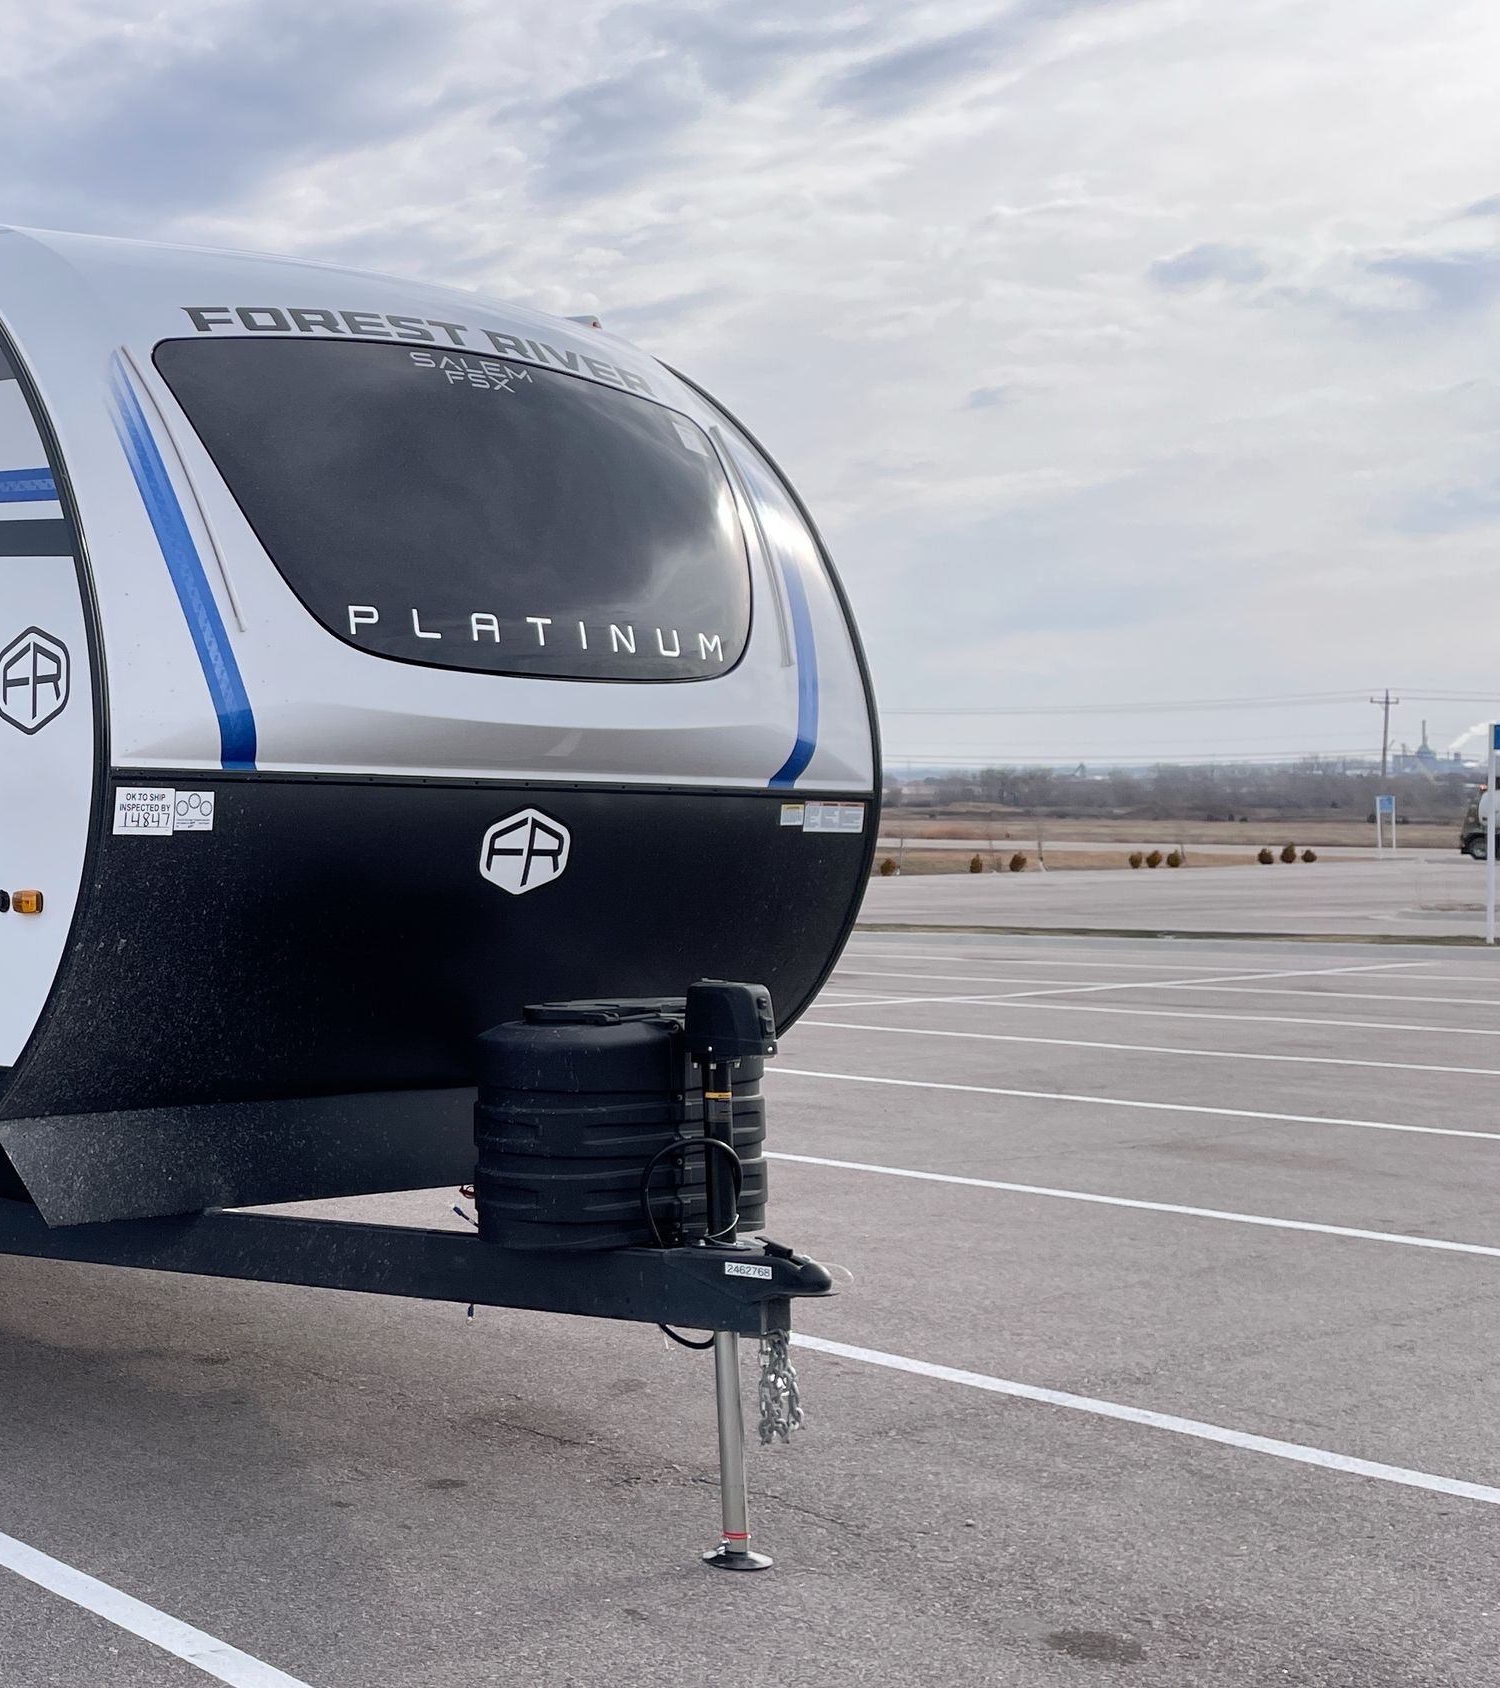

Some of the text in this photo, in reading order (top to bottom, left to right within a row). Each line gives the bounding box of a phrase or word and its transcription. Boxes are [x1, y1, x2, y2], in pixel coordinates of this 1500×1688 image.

[181, 306, 655, 397] FOREST RIVER
[409, 351, 534, 384] SALEM
[444, 369, 517, 394] FSX
[348, 604, 725, 662] PLATINUM
[119, 803, 171, 812] INSPECTED BY
[126, 793, 166, 802] OK TO SHIP
[124, 811, 170, 827] 14847
[726, 1263, 772, 1278] 2462768
